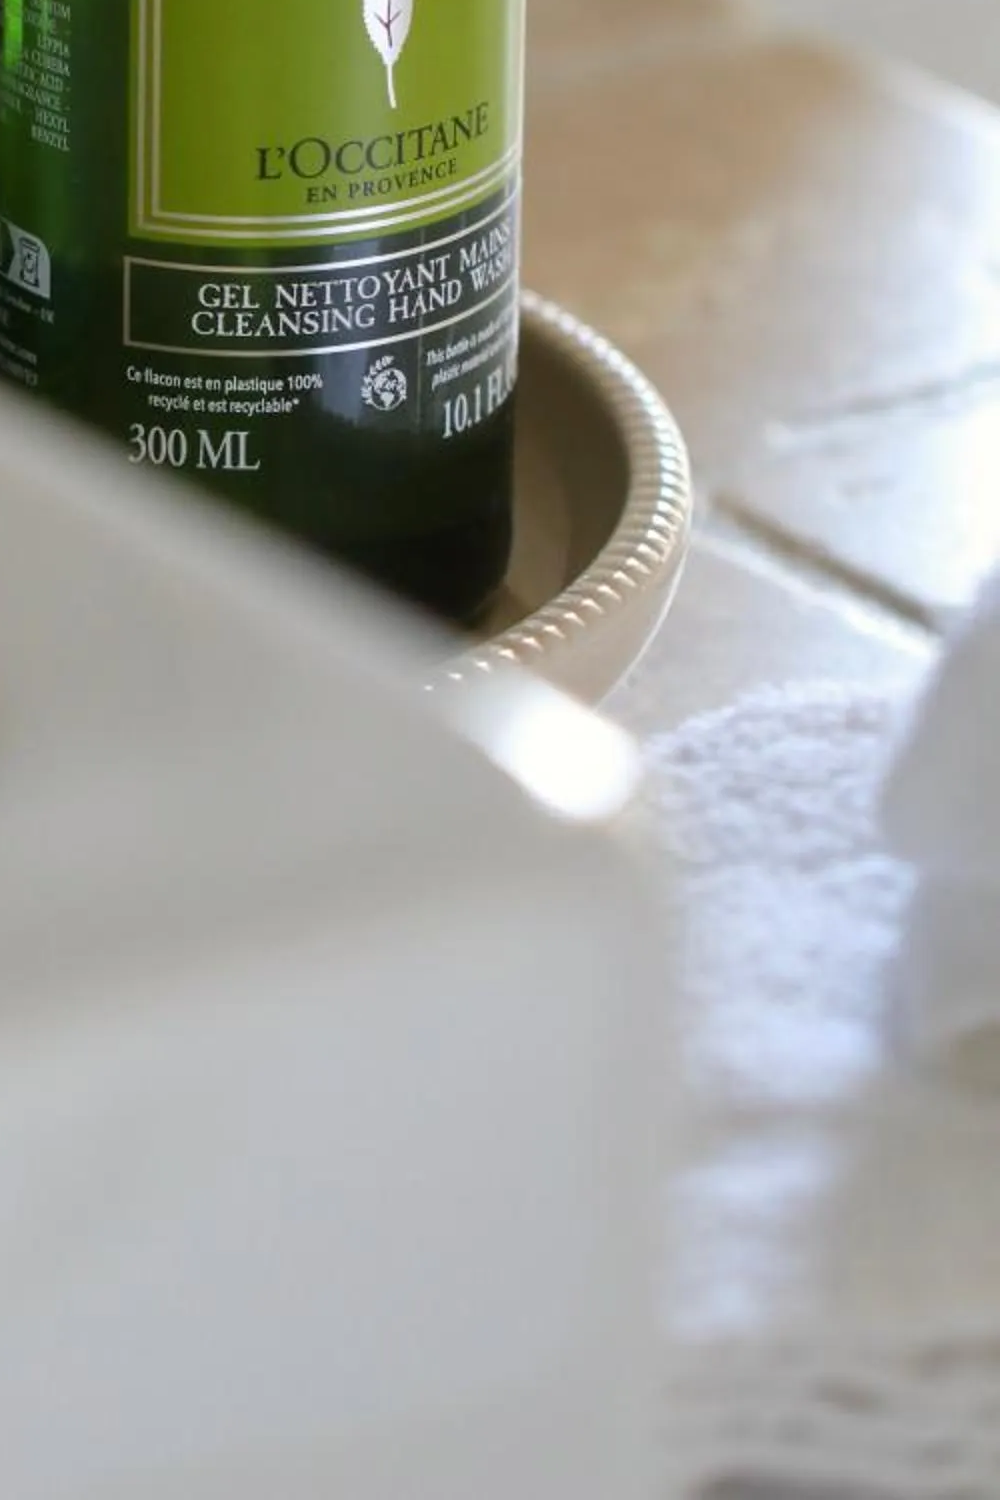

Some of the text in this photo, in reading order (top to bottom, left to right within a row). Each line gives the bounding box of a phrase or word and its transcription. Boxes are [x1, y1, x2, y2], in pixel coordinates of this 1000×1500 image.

[256, 101, 490, 181] L'OCCITANE
[306, 157, 457, 204] EN PROVENCE
[191, 303, 376, 338] CLEANSING
[388, 278, 463, 323] HAND
[198, 283, 260, 310] GEL
[275, 253, 451, 310] NETTOYANT
[126, 364, 325, 396] Ce flacon est en plastique 100%
[148, 394, 190, 413] recyclé
[193, 398, 206, 413] et
[208, 399, 228, 414] est
[442, 382, 482, 440] 10.1
[128, 422, 262, 471] 300 ML
